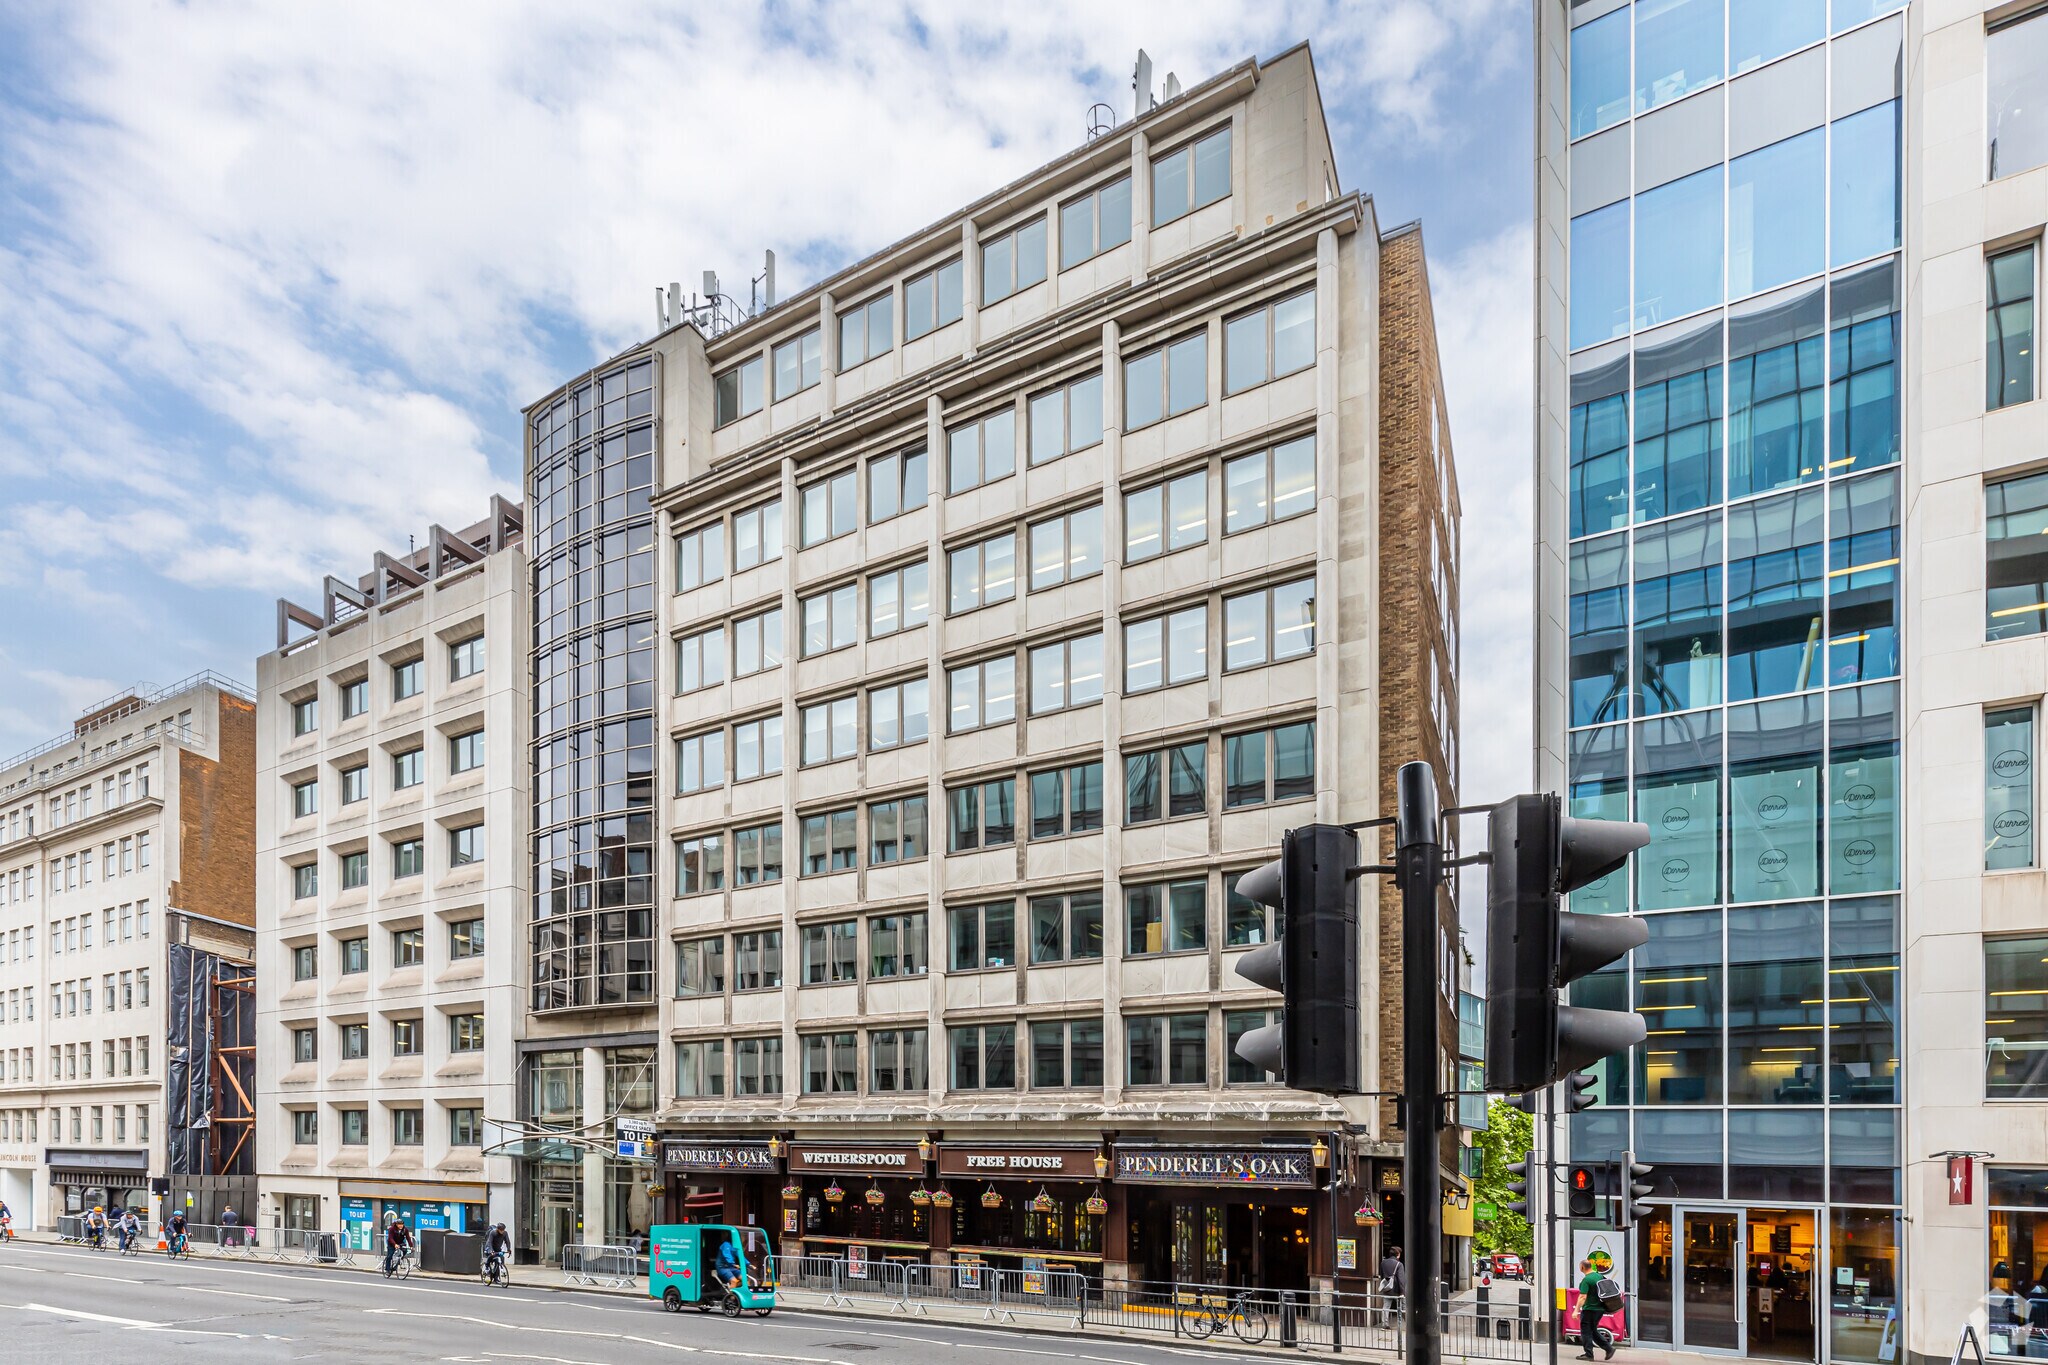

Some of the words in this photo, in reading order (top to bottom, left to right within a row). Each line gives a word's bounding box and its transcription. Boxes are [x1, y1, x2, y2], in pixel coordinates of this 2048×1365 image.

[623, 1131, 635, 1141] TO
[0, 1154, 18, 1162] INCOLN
[21, 1154, 36, 1162] HOUSE
[667, 1148, 733, 1163] PENDEREL'S
[737, 1150, 770, 1163] OAK
[802, 1152, 907, 1166] WETHERSPOON
[966, 1155, 1006, 1167] FREE
[1009, 1156, 1063, 1169] HOUSE
[1125, 1155, 1244, 1173] PENDEREL'S
[1250, 1158, 1300, 1175] OAK
[357, 1211, 366, 1219] LET
